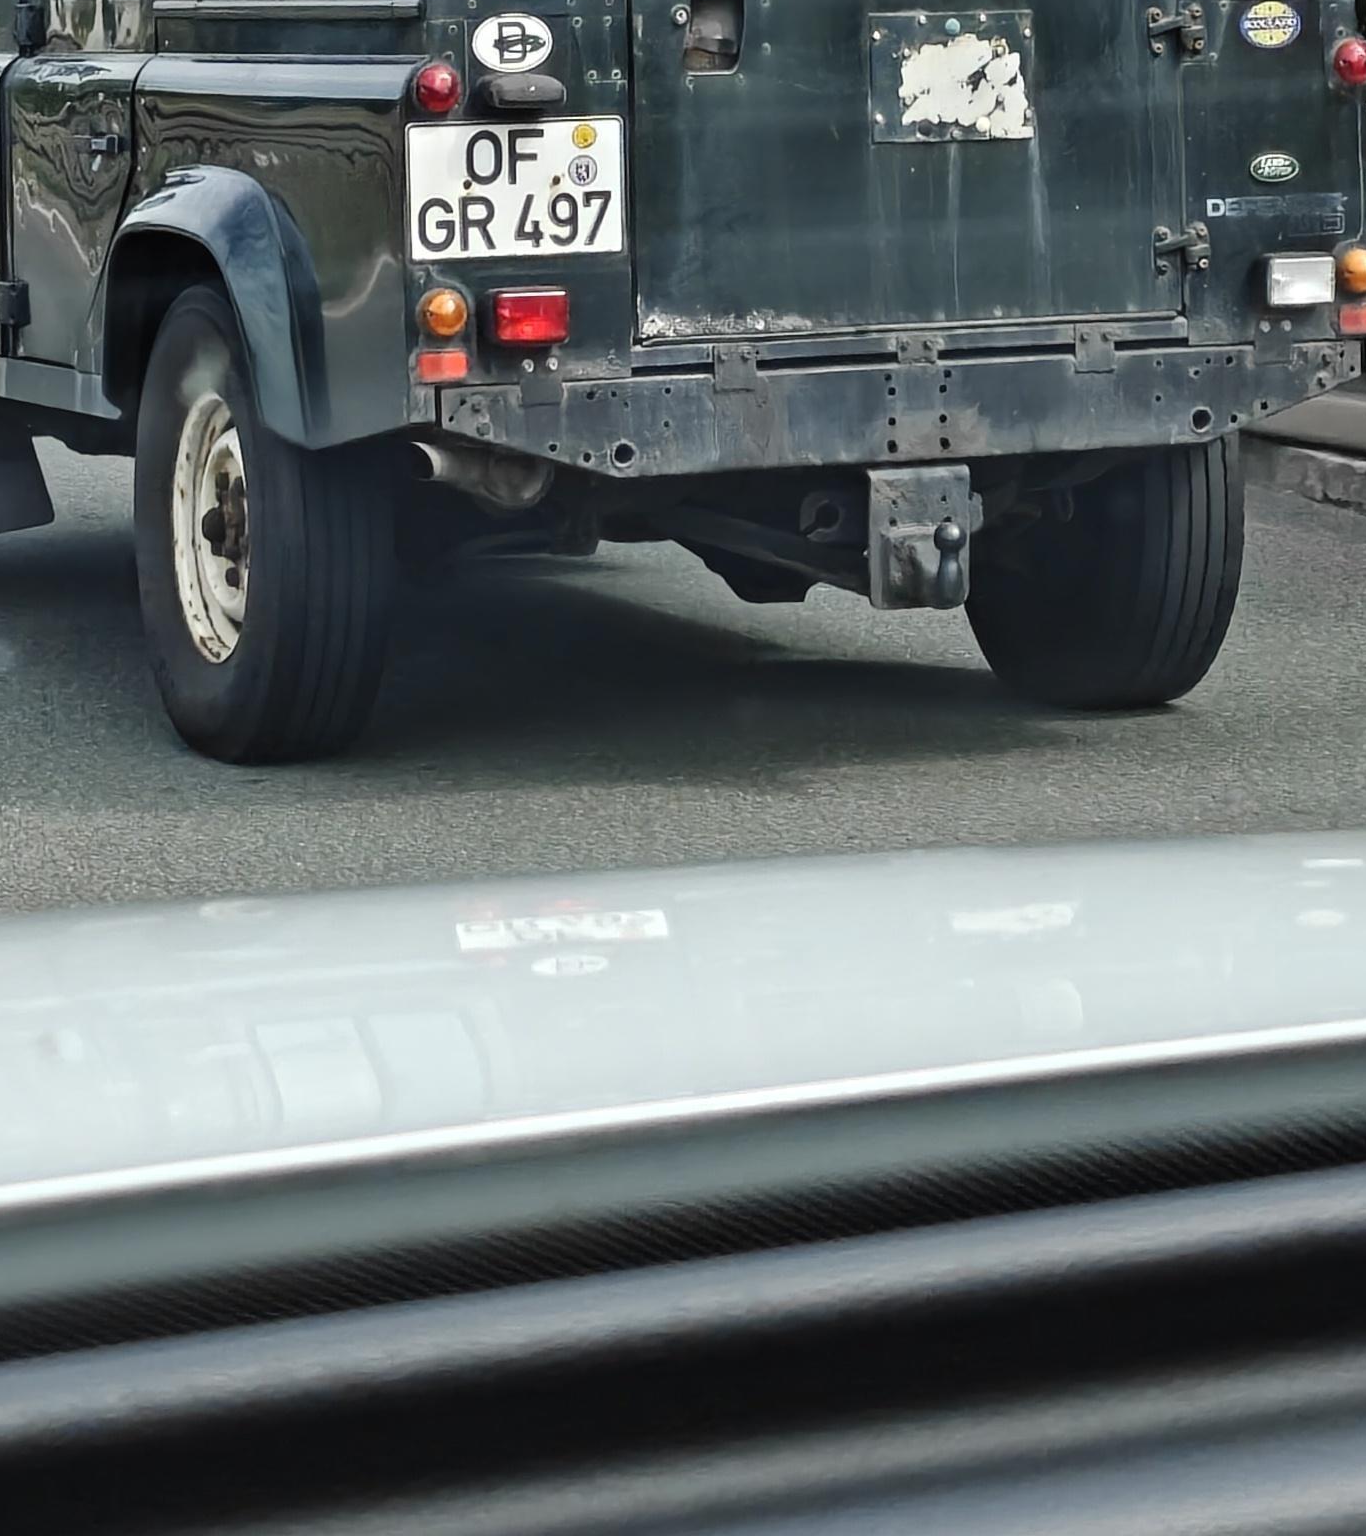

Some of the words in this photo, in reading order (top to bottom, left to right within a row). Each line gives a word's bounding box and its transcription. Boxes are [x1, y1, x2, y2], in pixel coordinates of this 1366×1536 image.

[465, 128, 545, 186] OF
[417, 195, 497, 252] GR
[513, 190, 612, 248] 497
